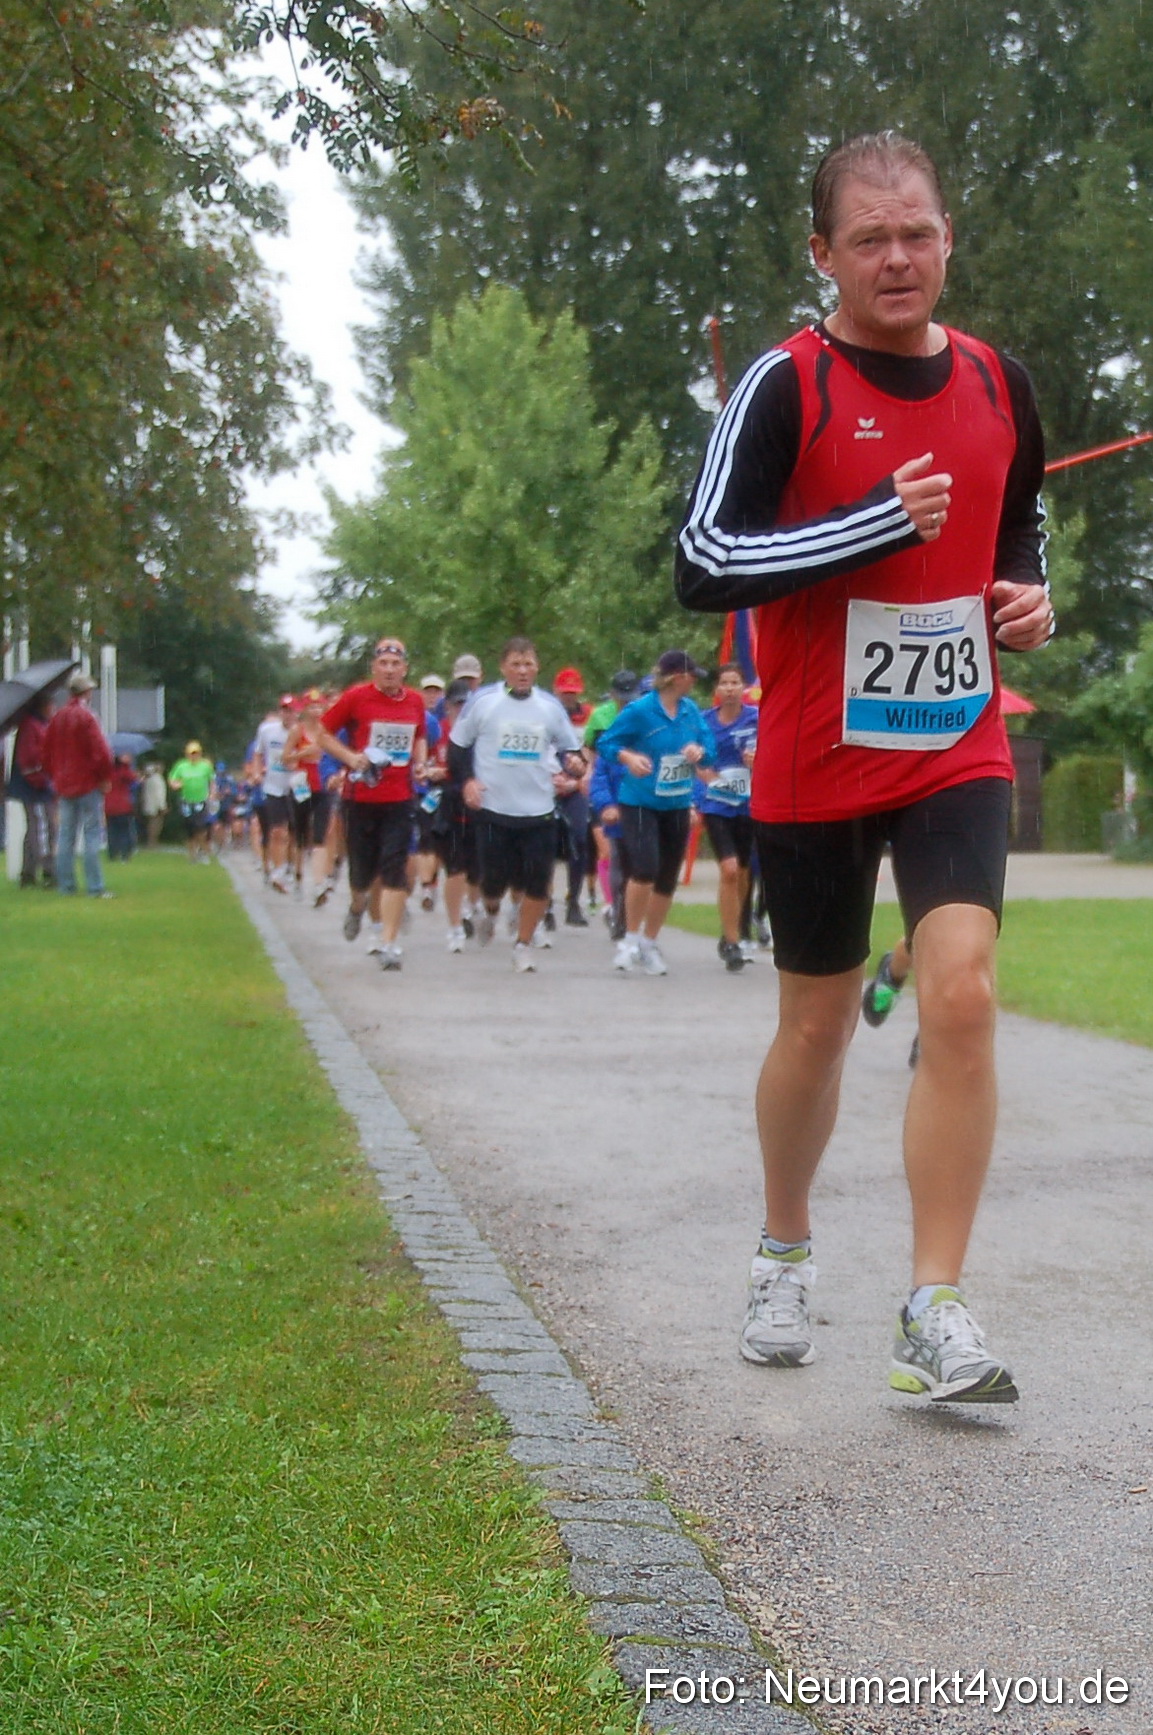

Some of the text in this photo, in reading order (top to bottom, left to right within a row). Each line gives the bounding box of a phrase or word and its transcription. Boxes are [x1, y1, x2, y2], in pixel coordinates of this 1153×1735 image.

[899, 610, 953, 628] BOCK
[863, 636, 979, 696] 2793
[885, 706, 966, 729] Wilfried
[503, 734, 539, 750] 2387
